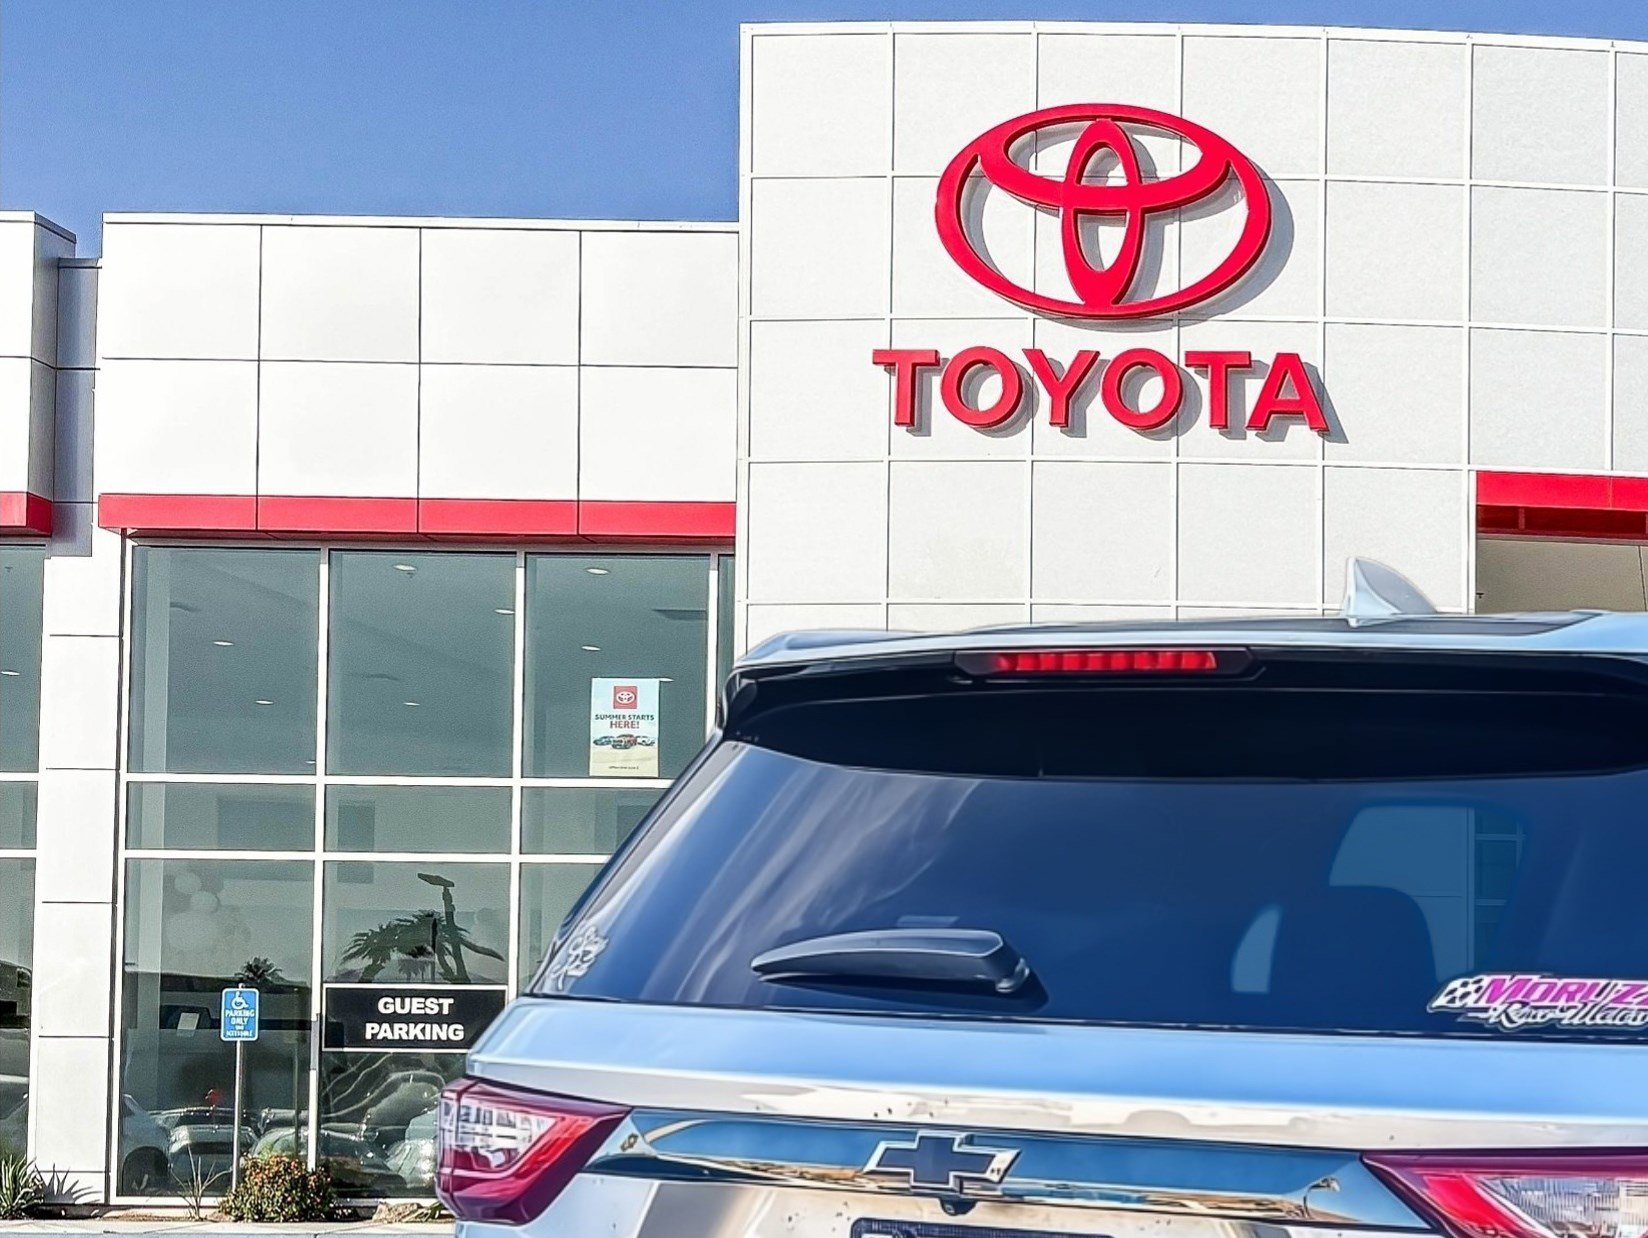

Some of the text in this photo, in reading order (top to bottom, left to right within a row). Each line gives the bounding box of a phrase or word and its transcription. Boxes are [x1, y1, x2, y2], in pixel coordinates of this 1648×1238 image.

[872, 345, 1330, 433] TOYOTA
[610, 720, 640, 729] HERE!
[377, 996, 454, 1015] GUEST
[225, 1009, 255, 1017] PARKING
[230, 1017, 249, 1025] ONLY
[364, 1022, 465, 1041] PARKING
